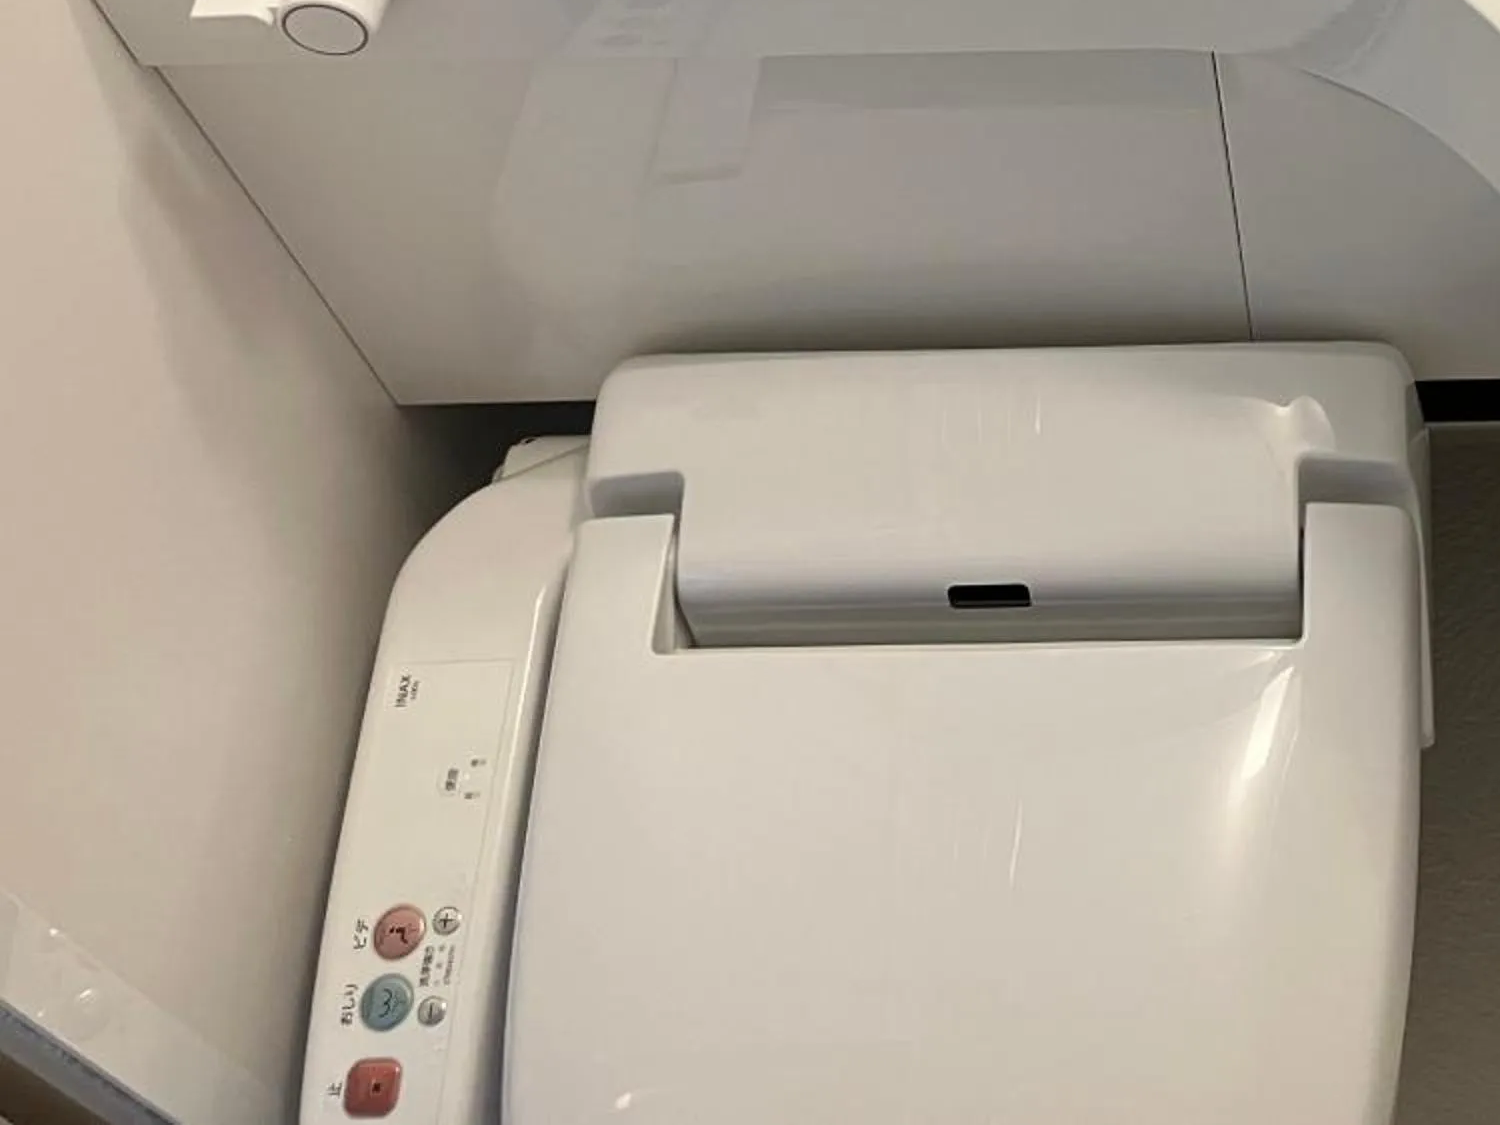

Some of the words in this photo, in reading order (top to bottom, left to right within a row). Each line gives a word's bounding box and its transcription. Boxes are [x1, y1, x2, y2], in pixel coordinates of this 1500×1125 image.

[394, 674, 411, 708] INAX
[353, 918, 369, 950] ビデ
[341, 982, 358, 1026] おしり
